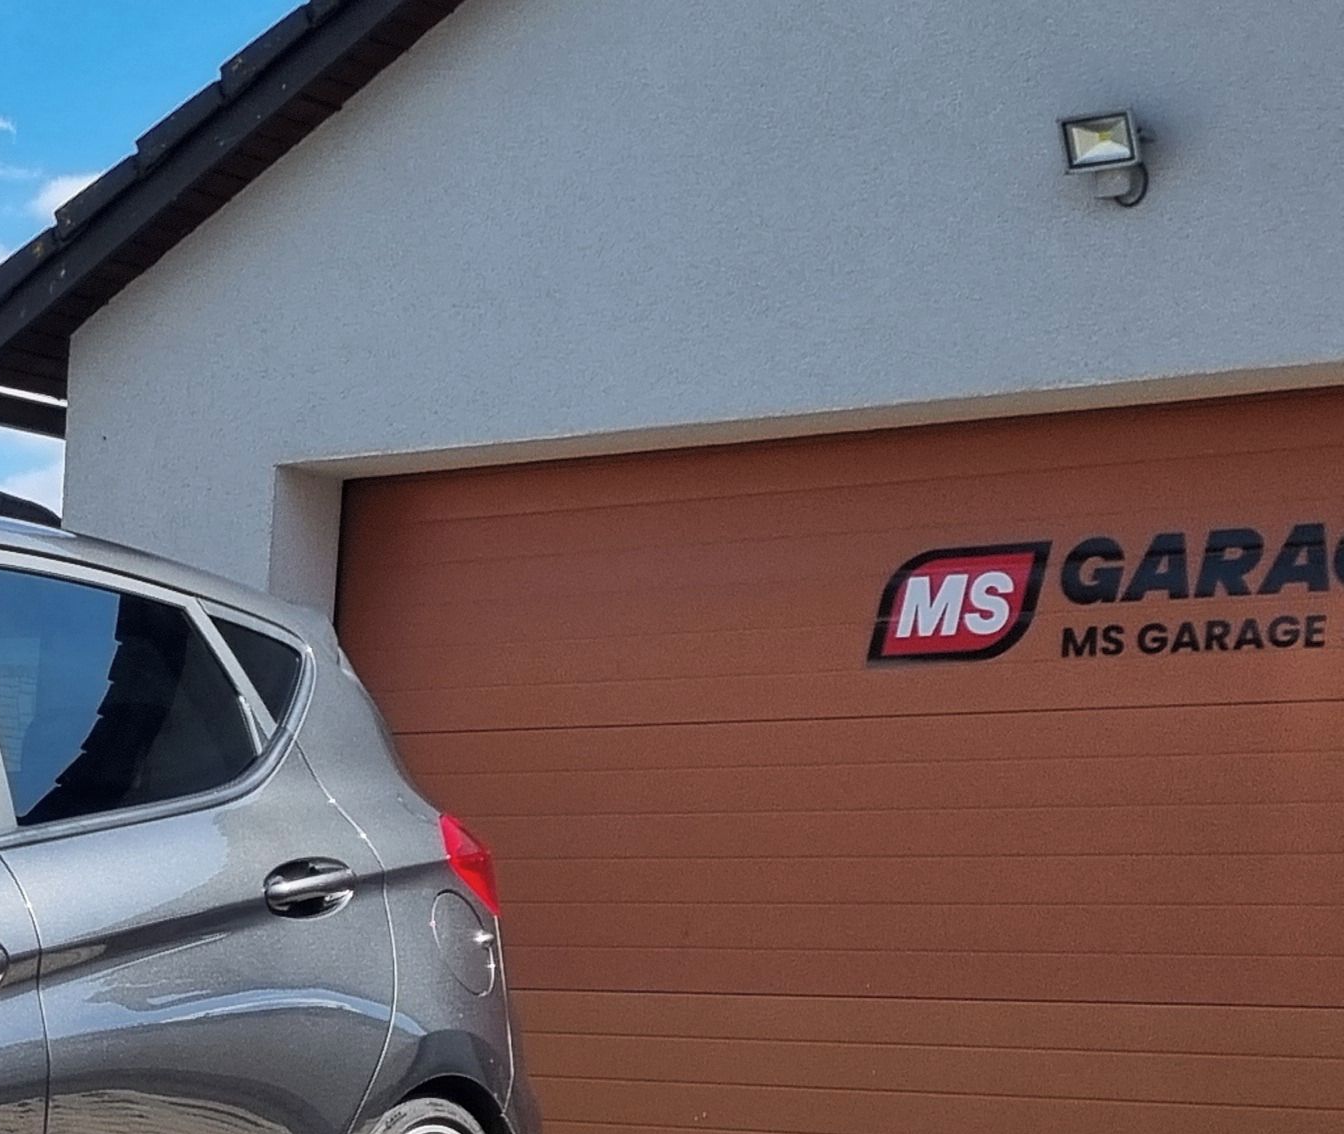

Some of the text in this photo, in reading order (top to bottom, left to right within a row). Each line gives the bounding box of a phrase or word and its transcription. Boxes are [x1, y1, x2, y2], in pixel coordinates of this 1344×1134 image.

[1060, 522, 1344, 605] GARA
[895, 571, 1015, 638] MS
[1062, 614, 1327, 658] MS GARAGE
